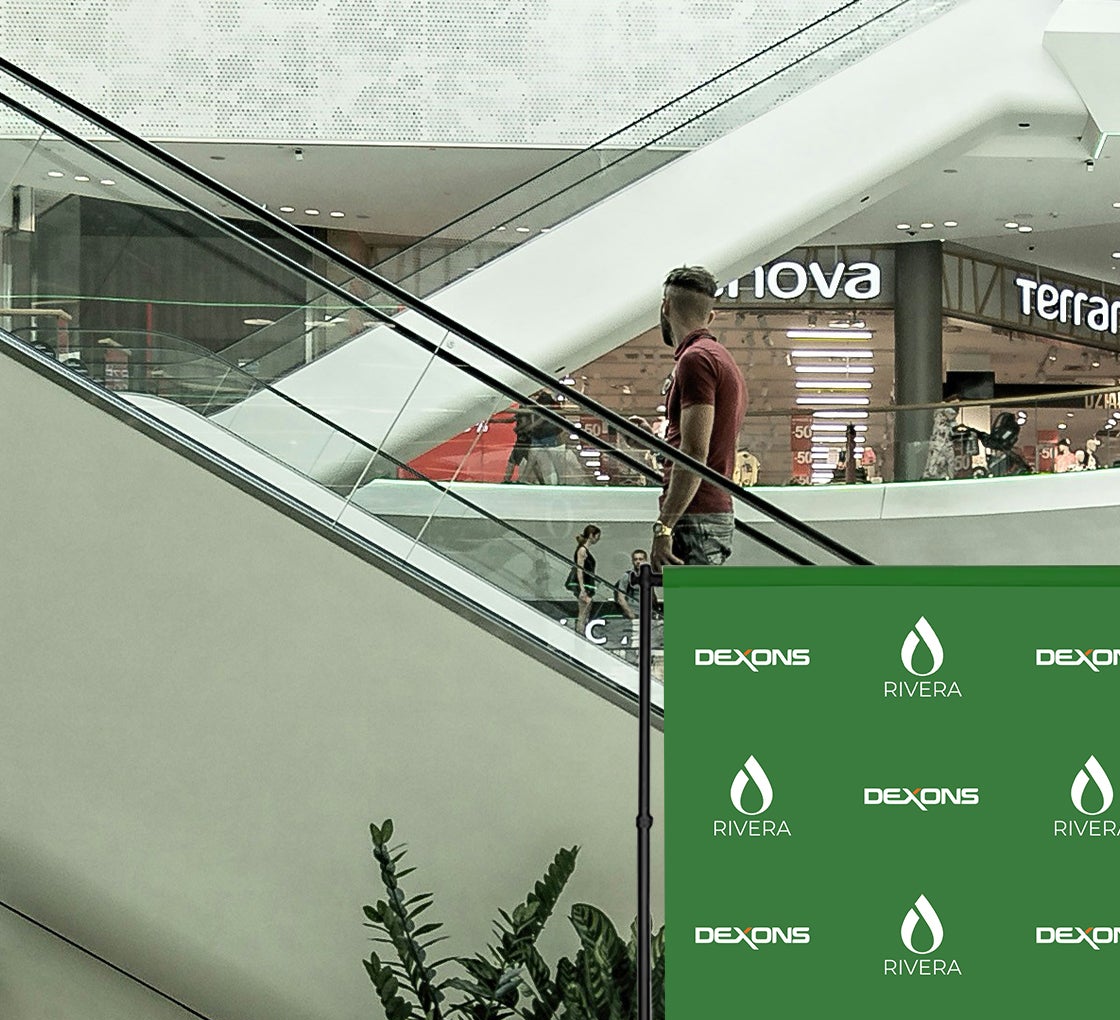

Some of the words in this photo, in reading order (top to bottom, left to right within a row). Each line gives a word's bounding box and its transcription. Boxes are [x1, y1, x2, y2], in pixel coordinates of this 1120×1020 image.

[714, 261, 881, 299] nova
[695, 649, 810, 672] DEXONS
[885, 682, 962, 697] RIVERA
[864, 788, 979, 811] DEXONS
[714, 821, 791, 836] RIVERA
[695, 927, 810, 950] DEXONS
[885, 960, 961, 975] RIVERA
